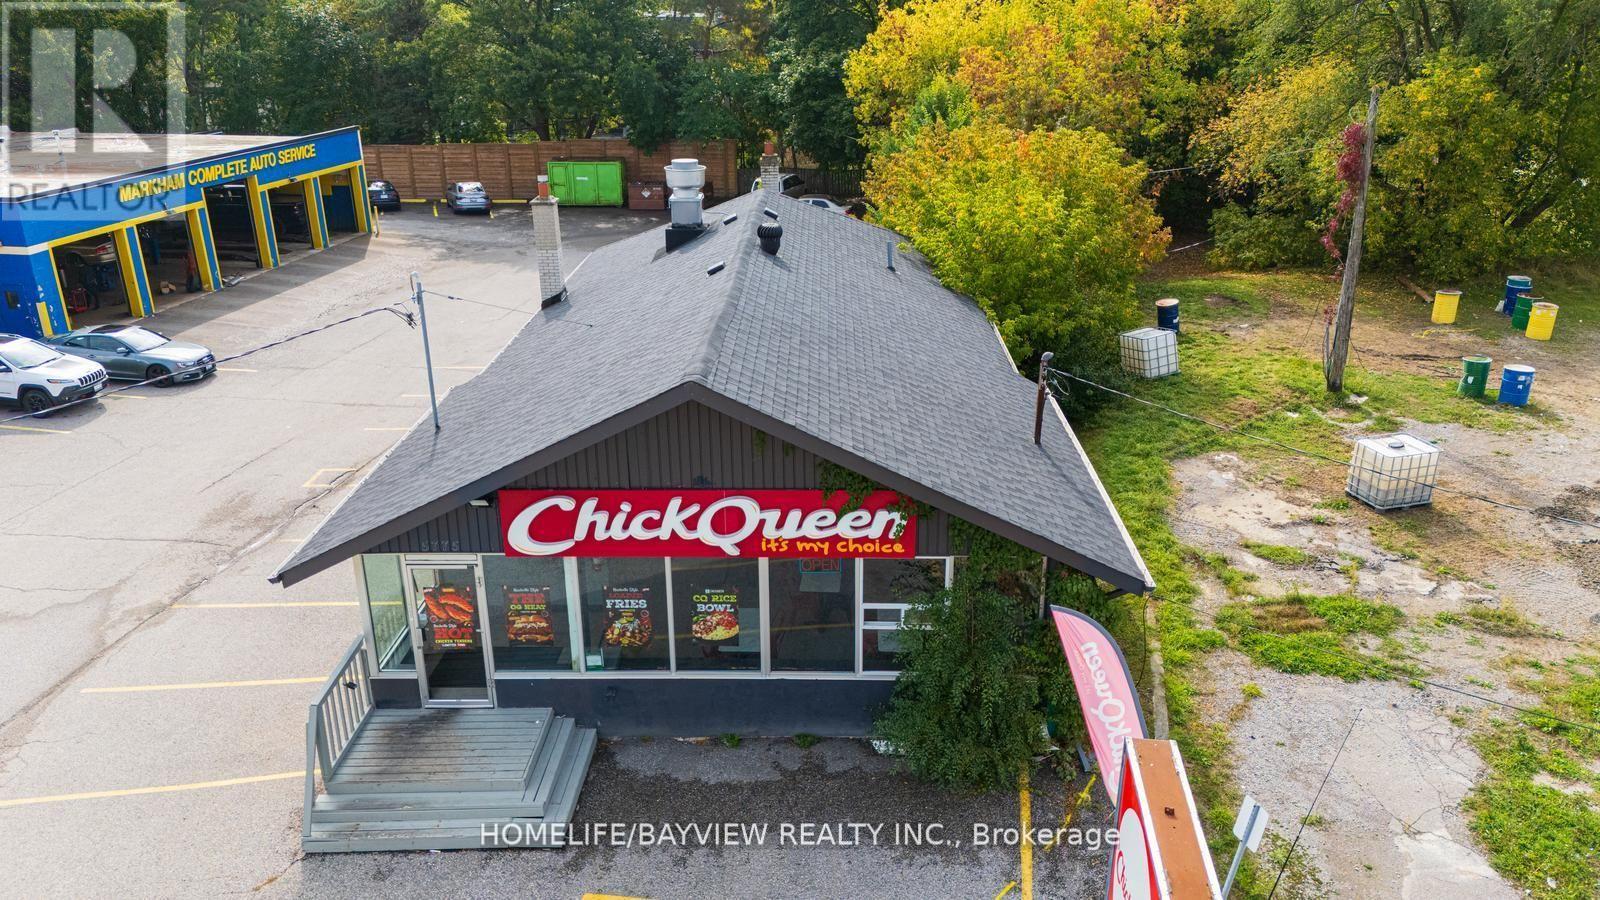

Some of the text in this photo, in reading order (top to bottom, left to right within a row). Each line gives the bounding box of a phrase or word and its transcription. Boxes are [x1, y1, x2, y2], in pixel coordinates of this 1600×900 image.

[119, 143, 316, 202] MARKHAM COMPLETE AUTO SERVICE
[507, 495, 907, 556] ChickQueen
[761, 538, 905, 555] it's my choice
[801, 558, 840, 571] OPEN
[606, 599, 647, 609] FRIES
[697, 603, 734, 612] BOWL
